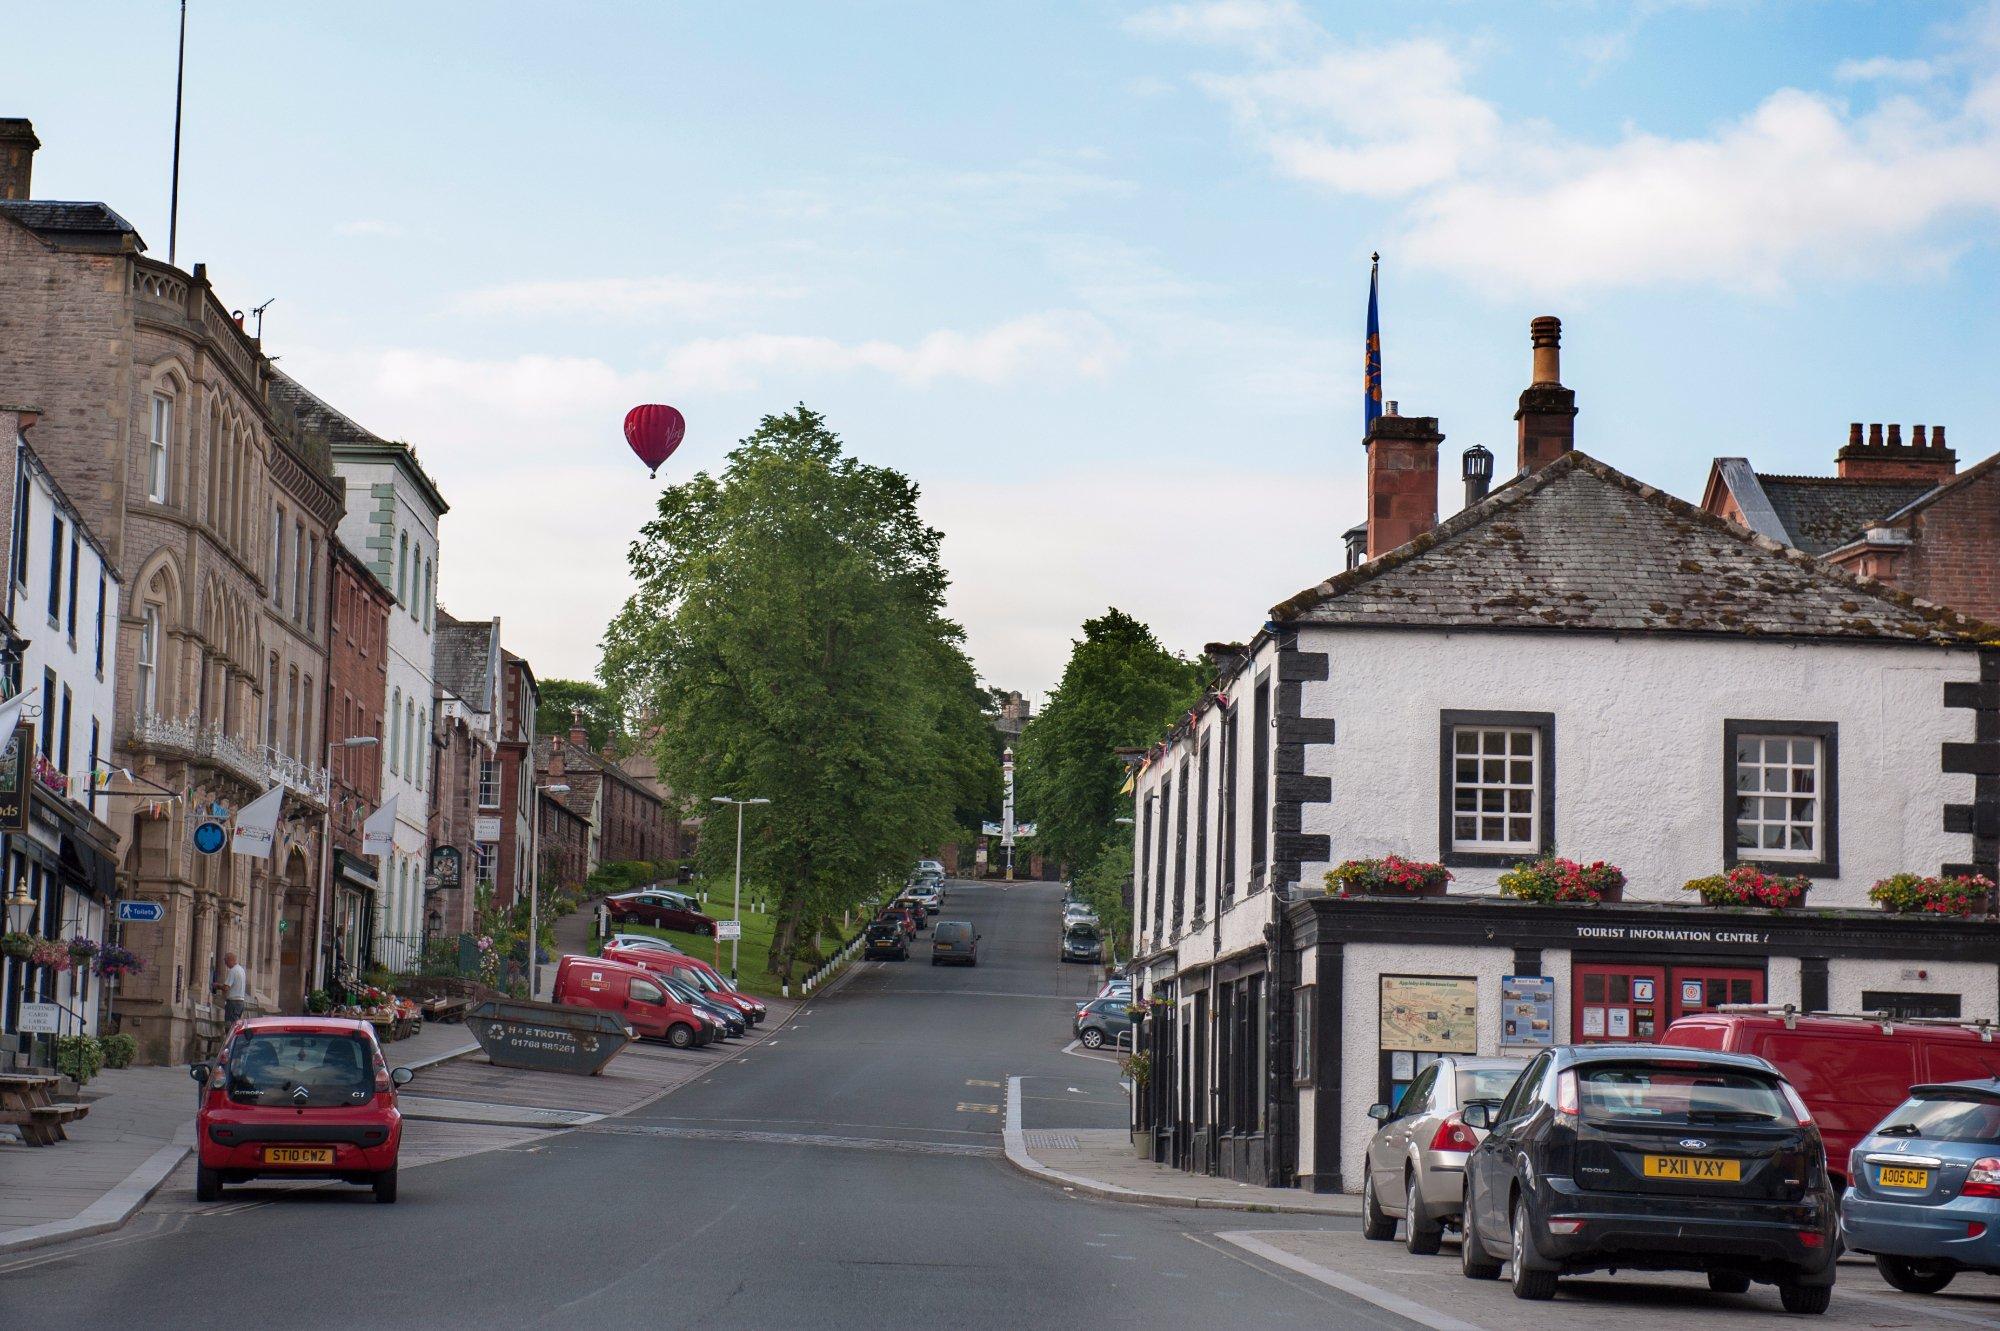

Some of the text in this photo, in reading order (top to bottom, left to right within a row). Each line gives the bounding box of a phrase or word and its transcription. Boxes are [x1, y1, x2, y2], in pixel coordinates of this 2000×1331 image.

[1577, 927, 1625, 938] TOURIST
[1629, 929, 1711, 941] INFORMATION
[1715, 932, 1759, 943] CENTRE
[508, 1025, 516, 1034] H
[1658, 1158, 1725, 1177] PX11 VXY
[1907, 1171, 1926, 1185] GJF
